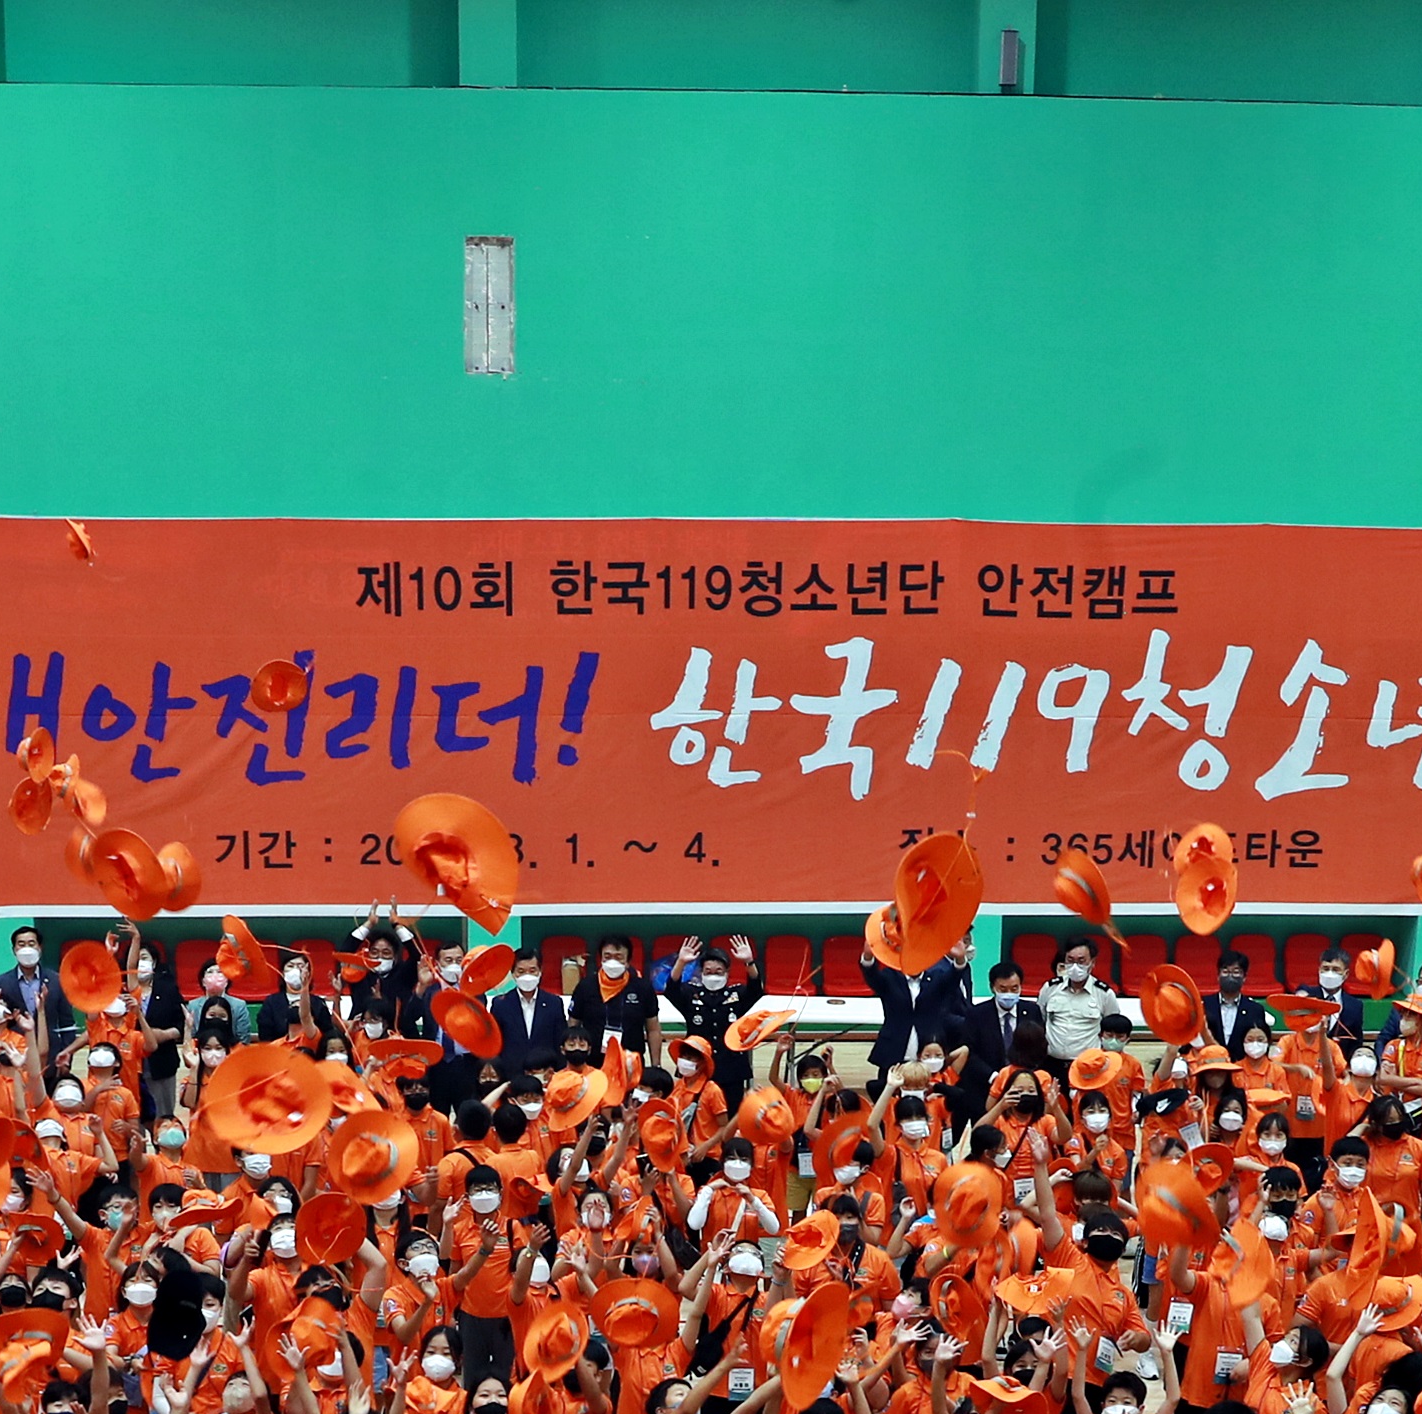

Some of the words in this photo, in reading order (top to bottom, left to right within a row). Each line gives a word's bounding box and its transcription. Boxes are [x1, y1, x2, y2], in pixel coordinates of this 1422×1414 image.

[355, 560, 514, 618] 제10회
[548, 559, 946, 619] 한국119청소년단
[976, 562, 1180, 621] 안전캠프
[214, 829, 297, 870] 기간
[564, 832, 596, 869] 1.
[683, 831, 721, 868] 4.
